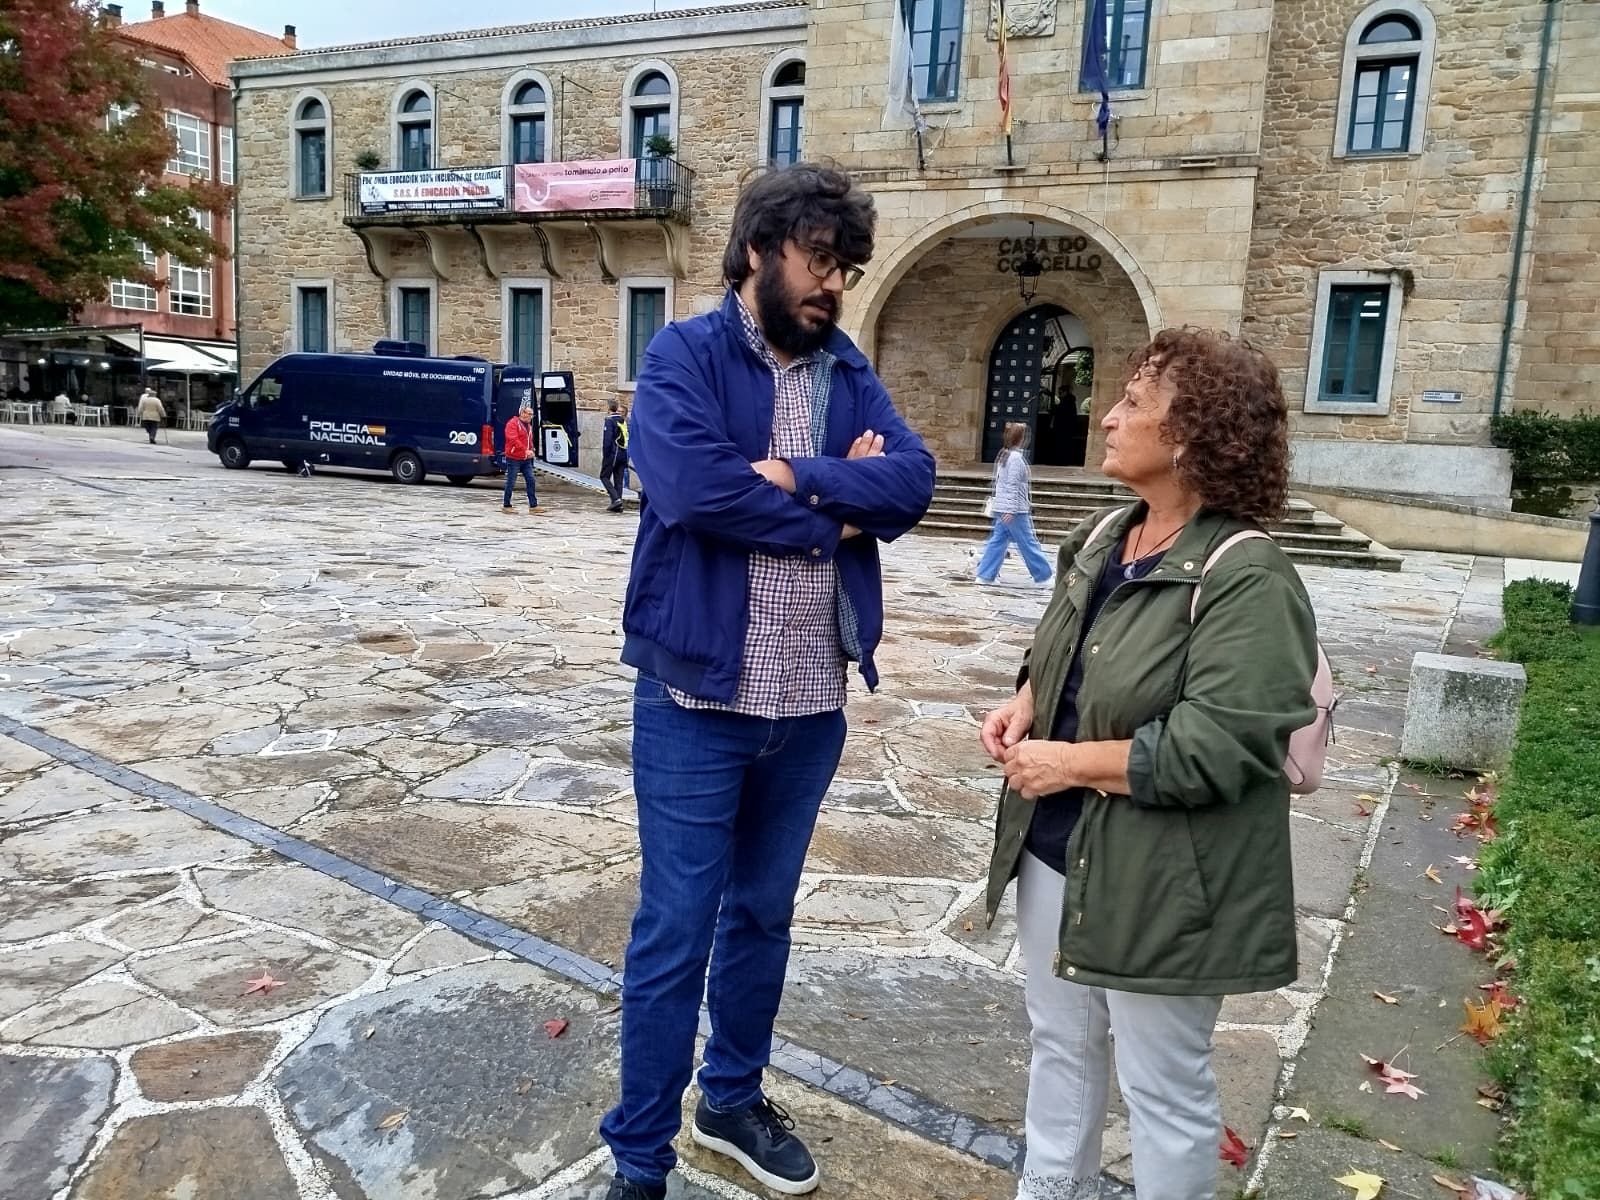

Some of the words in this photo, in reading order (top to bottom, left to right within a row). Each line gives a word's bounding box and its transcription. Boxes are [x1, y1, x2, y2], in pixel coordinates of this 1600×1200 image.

[390, 174, 419, 184] EDUCACIÓN
[474, 170, 501, 181] CALIDADE
[421, 185, 460, 197] EDUCACIÓN
[998, 238, 1048, 254] CASA
[1058, 235, 1087, 252] DO
[997, 254, 1102, 273] COCELLO
[403, 371, 420, 379] MÓVIL
[429, 373, 477, 382] DOCUMENTACIÓN
[310, 431, 387, 446] NACIONAL
[449, 430, 478, 446] 200
